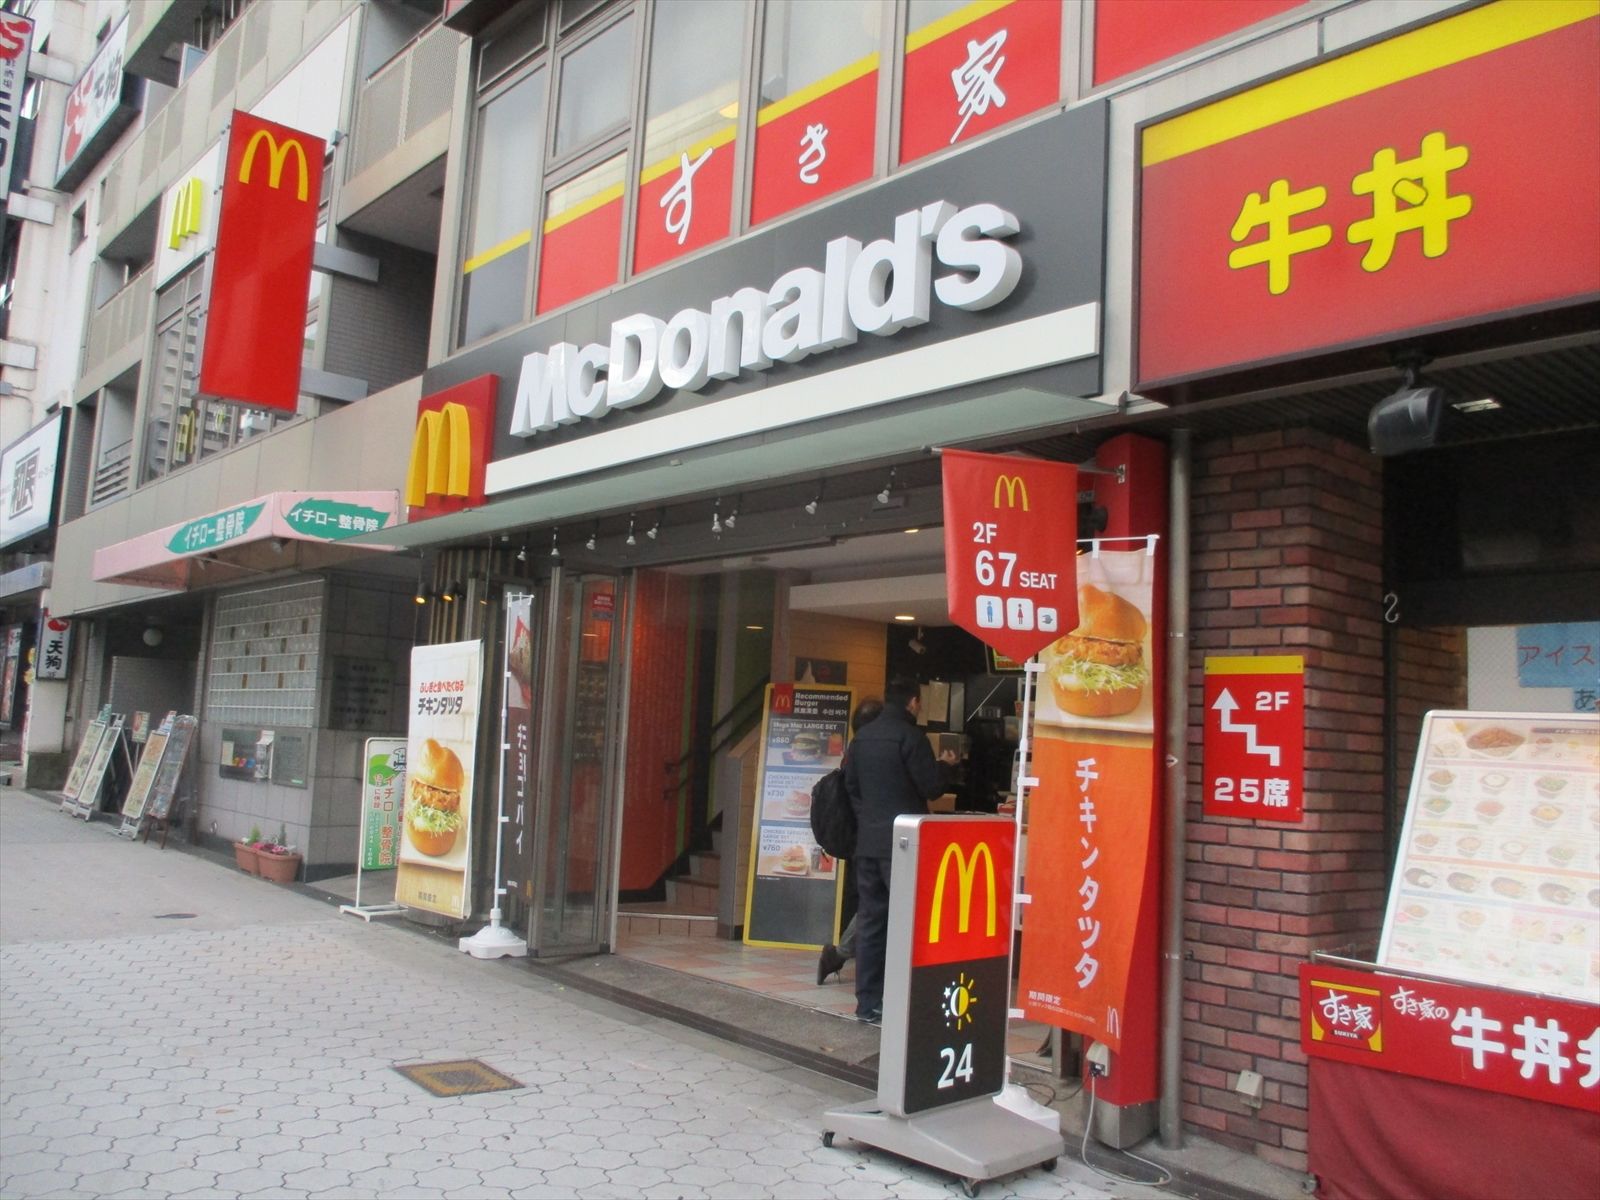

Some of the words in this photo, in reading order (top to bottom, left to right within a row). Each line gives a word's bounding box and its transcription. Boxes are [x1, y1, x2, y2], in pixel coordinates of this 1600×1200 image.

[1228, 131, 1474, 296] 牛丼
[509, 199, 1023, 438] McDonald's
[184, 510, 246, 550] イチロー整骨院
[290, 508, 380, 532] イチロー整骨院
[972, 521, 998, 544] 2F
[975, 550, 1017, 588] 67
[1019, 571, 1058, 590] SEAT
[45, 640, 64, 670] 天狗
[418, 697, 463, 715] チキンタツタ
[795, 692, 849, 701] Recommended
[1255, 690, 1290, 711] 2F
[1214, 777, 1290, 807] 25席
[379, 775, 395, 866] イチロー整骨院
[1074, 757, 1100, 989] チキンタツタ
[1319, 989, 1374, 1032] すき家
[1390, 985, 1450, 1021] すき家の
[937, 1043, 974, 1089] 24
